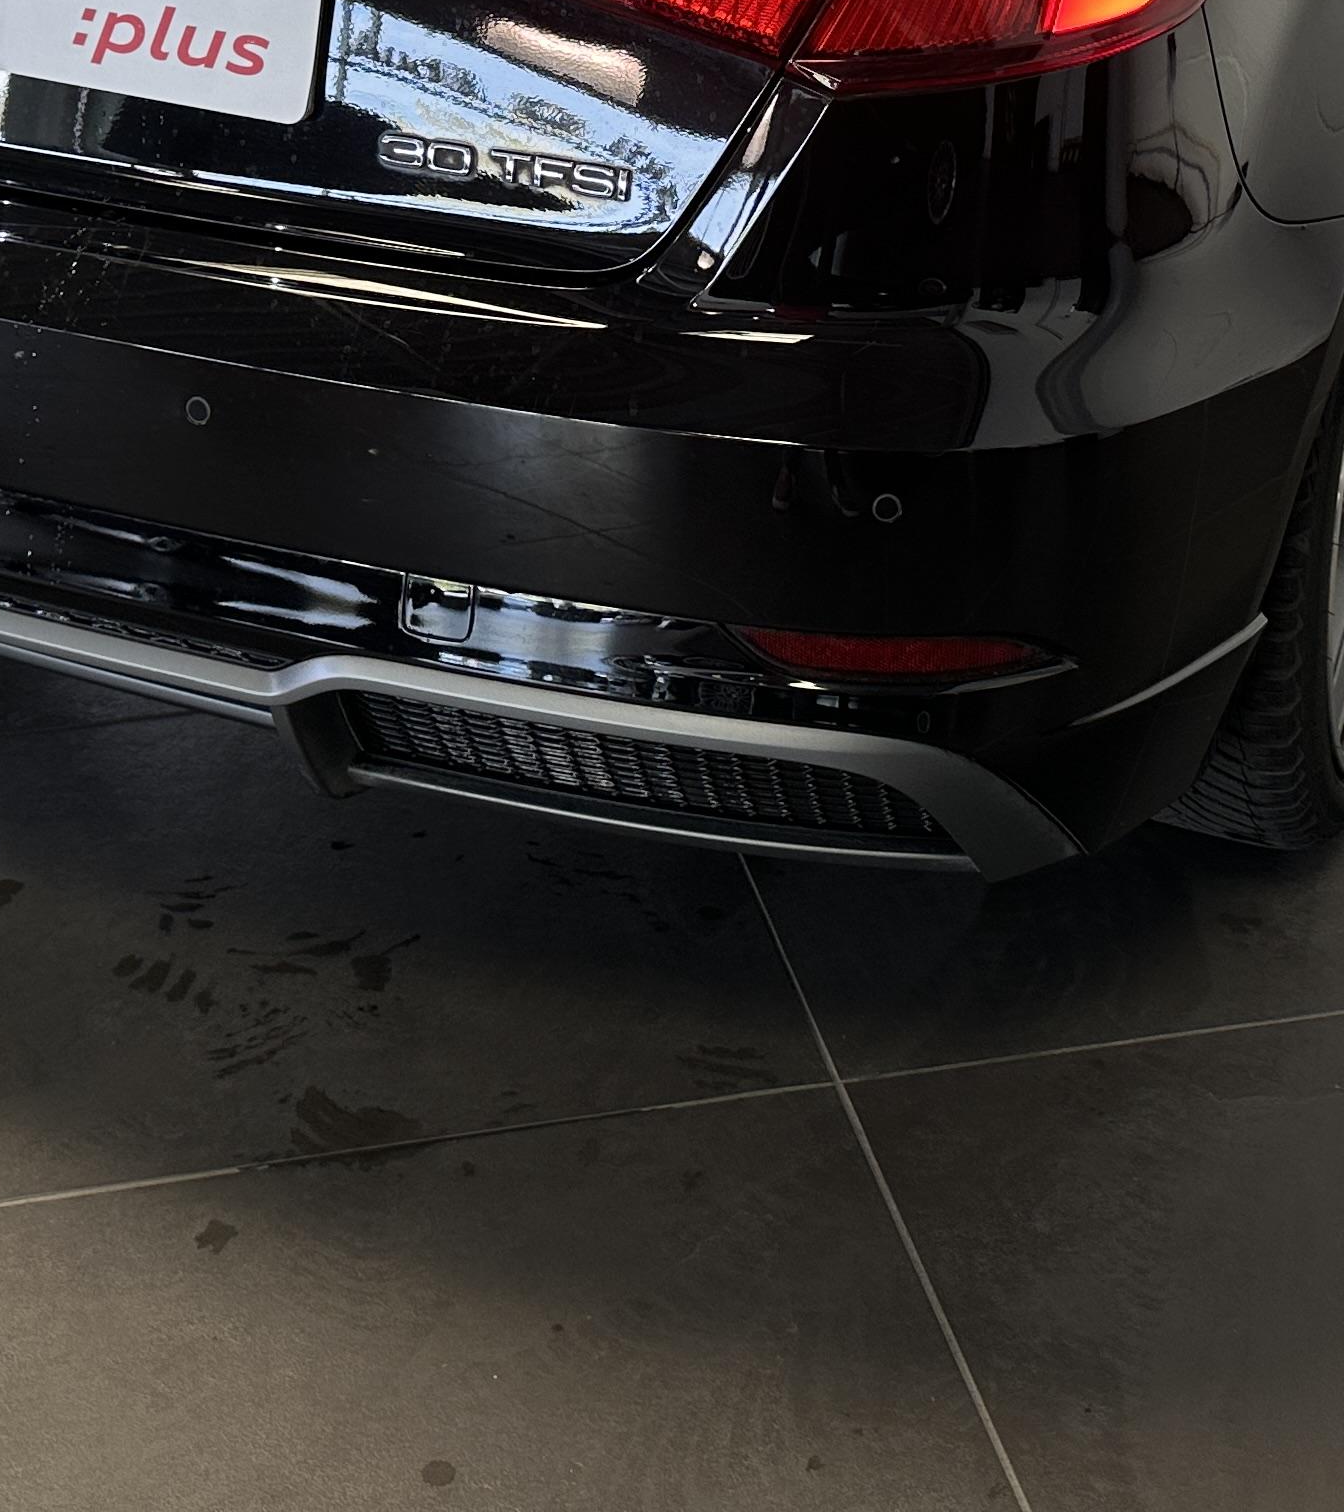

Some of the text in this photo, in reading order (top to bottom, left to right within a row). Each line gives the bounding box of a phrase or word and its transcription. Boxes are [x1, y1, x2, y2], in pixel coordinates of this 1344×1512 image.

[72, 6, 270, 76] :plus
[378, 131, 634, 202] 30 TFSI
